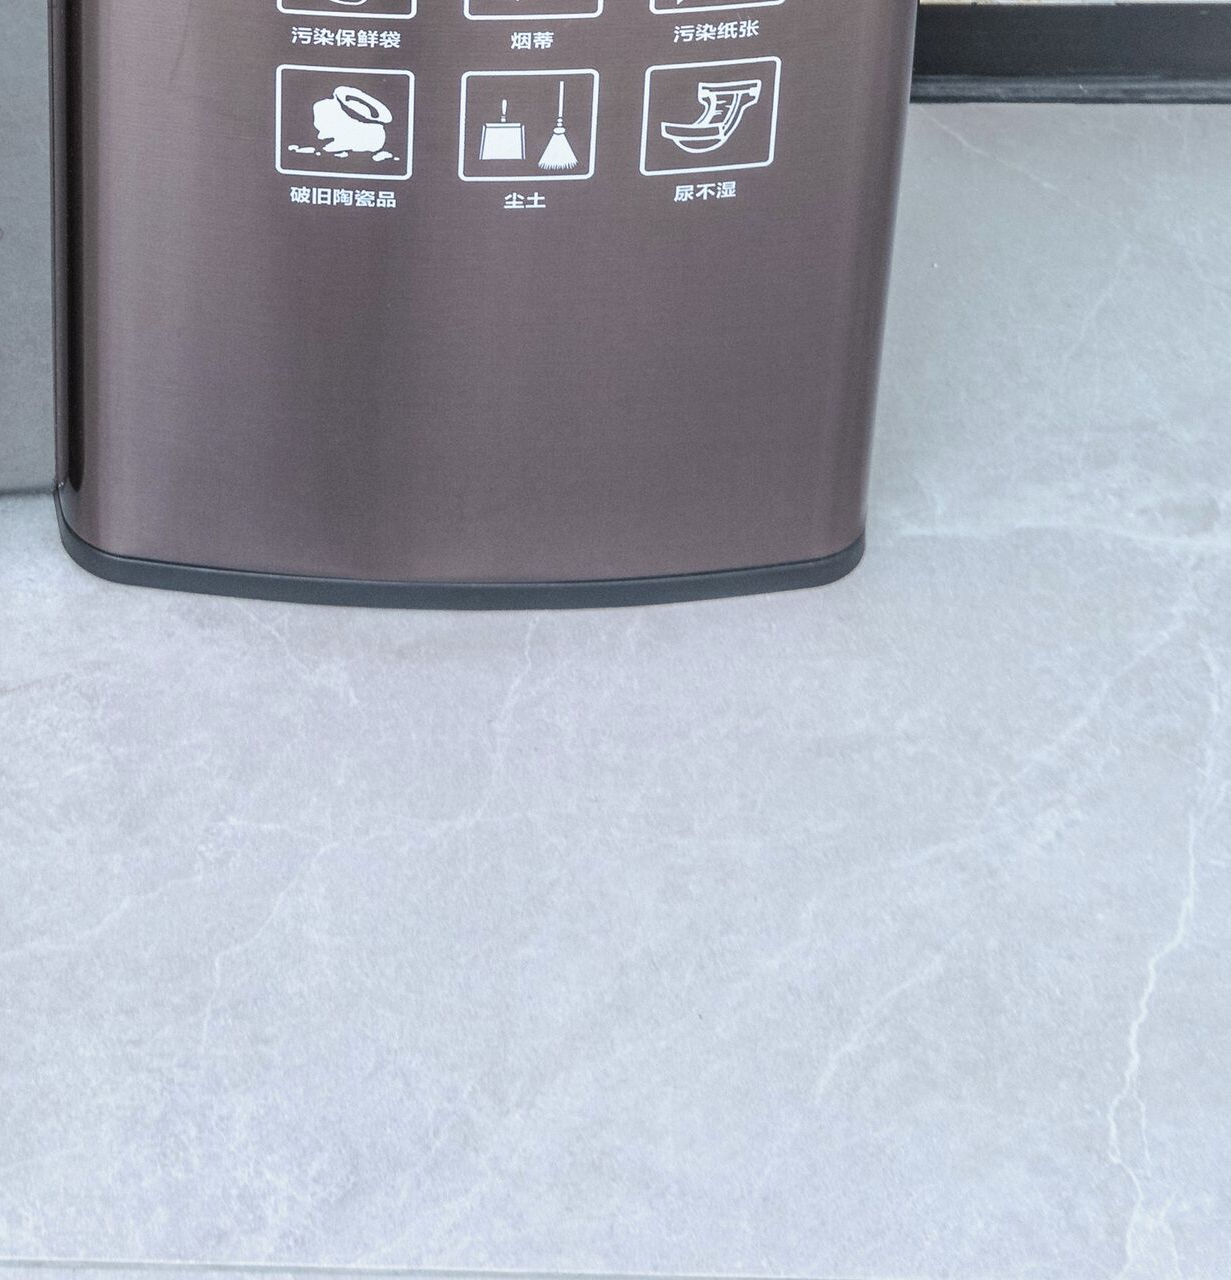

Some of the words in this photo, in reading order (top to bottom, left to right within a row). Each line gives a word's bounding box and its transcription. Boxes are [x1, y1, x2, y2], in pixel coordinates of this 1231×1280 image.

[290, 26, 401, 49] 污染保鲜袋
[510, 31, 555, 50] 烟蒂
[673, 19, 760, 43] 污染纸张
[289, 186, 397, 209] 破旧陶瓷品
[503, 191, 547, 210] 尘土
[673, 180, 737, 202] 尿不湿
